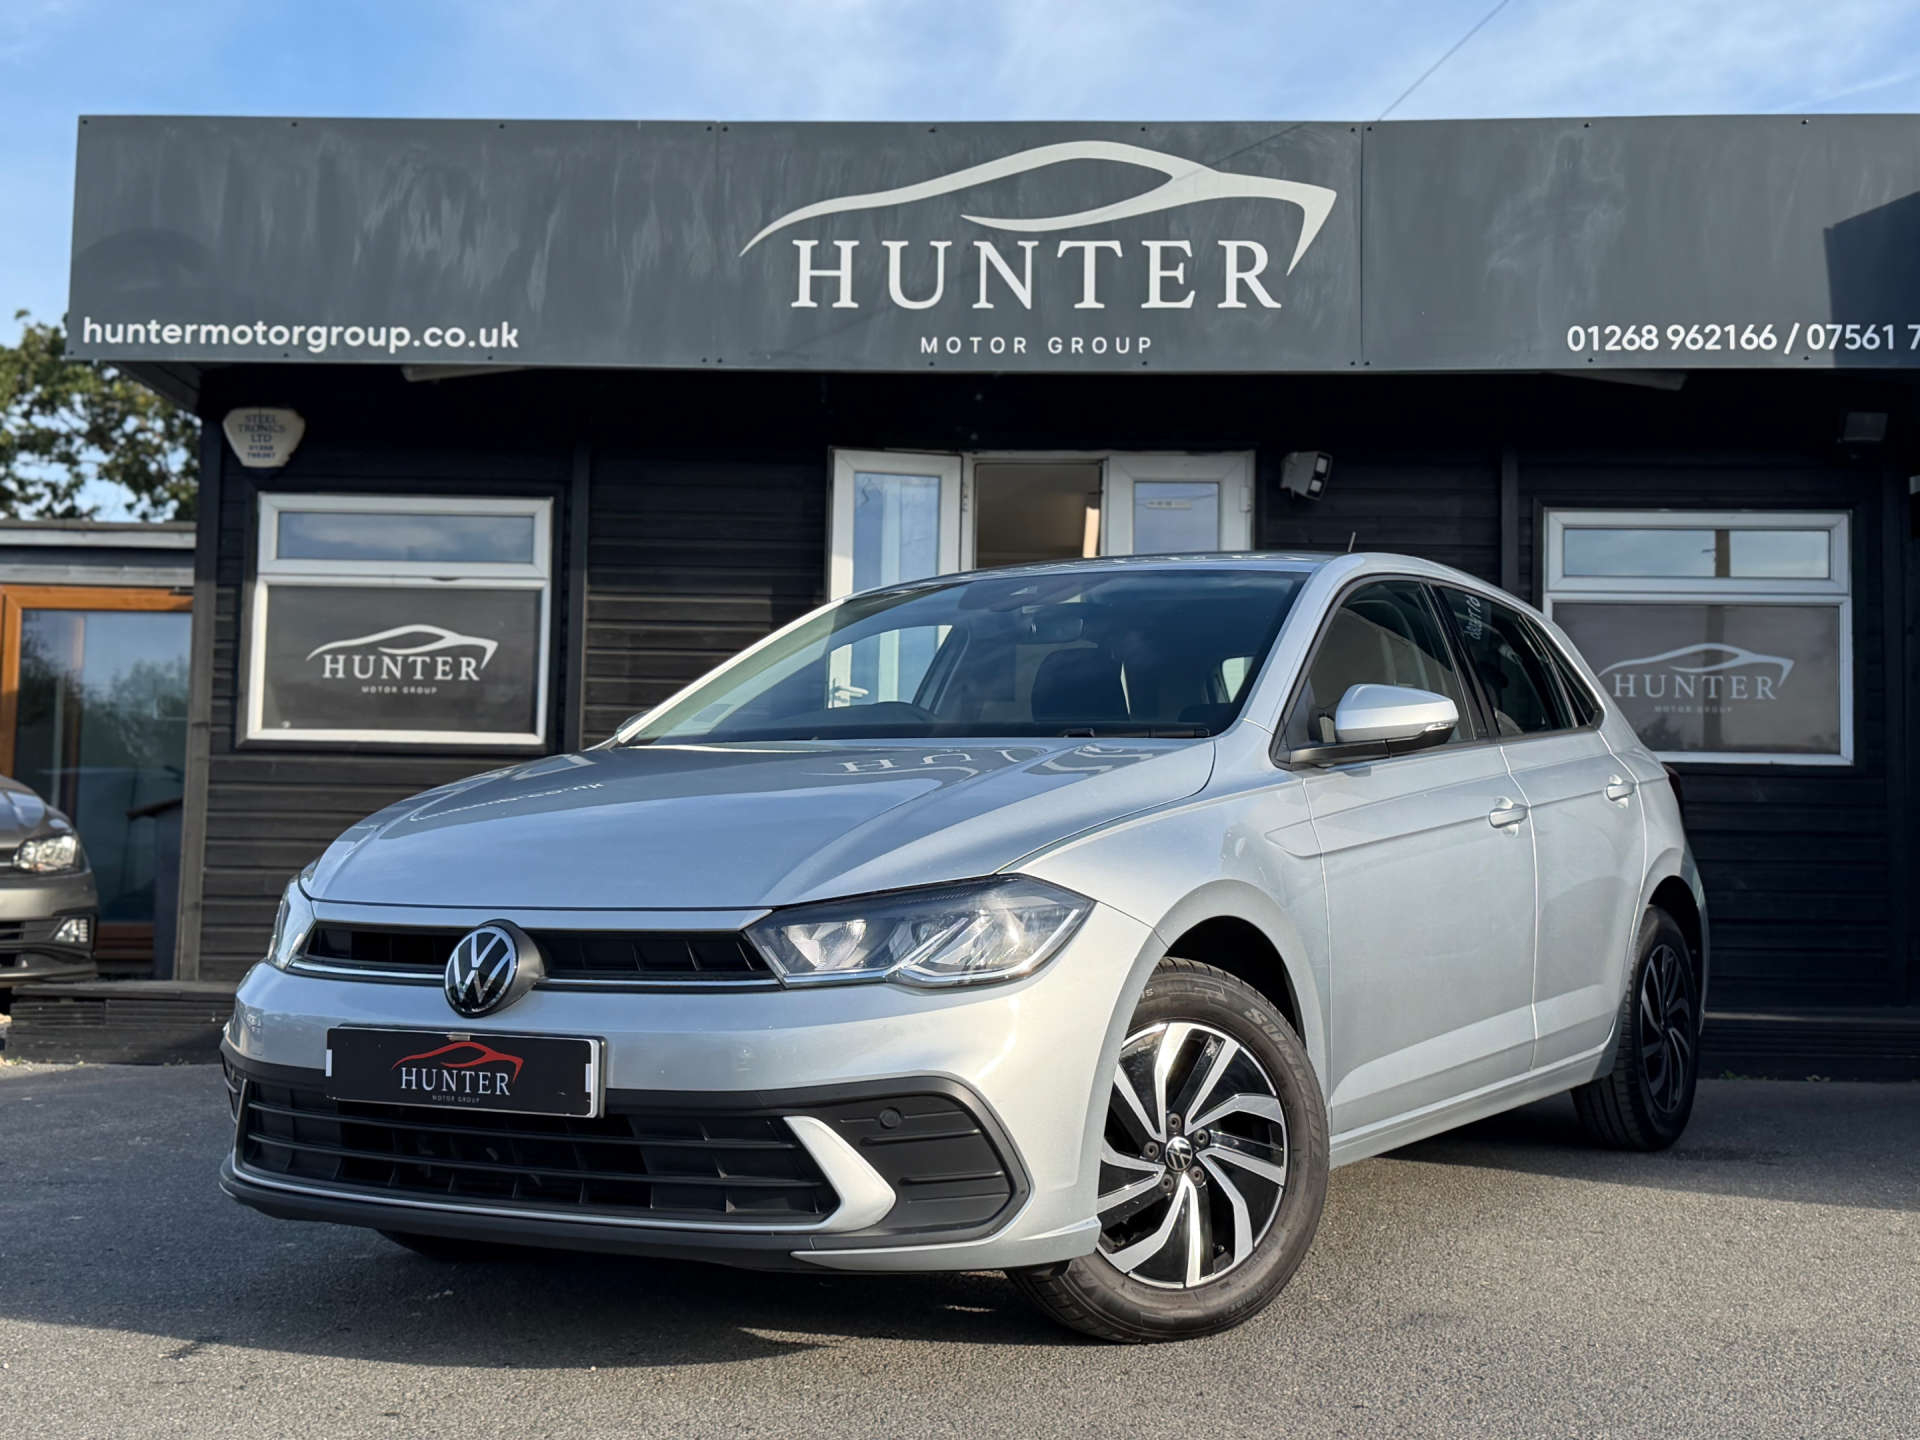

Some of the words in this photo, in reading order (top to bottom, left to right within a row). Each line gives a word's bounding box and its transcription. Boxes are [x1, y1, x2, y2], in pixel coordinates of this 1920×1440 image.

[790, 239, 1282, 310] HUNTER
[82, 316, 520, 354] huntermotorgroup.co.uk
[920, 336, 1027, 354] MOTOR
[1047, 336, 1153, 354] GROUP
[1566, 324, 1659, 351] 01268
[1666, 323, 1777, 351] 962166
[1783, 322, 1801, 354] /
[1806, 323, 1895, 350] 07561
[251, 433, 272, 443] LTD
[322, 654, 481, 681] HUNTER
[361, 685, 397, 694] MOTOR
[402, 685, 438, 694] GROUP
[1613, 673, 1777, 700] HUNTER
[1654, 705, 1691, 713] MOTOR
[401, 1067, 511, 1096] HUNTER
